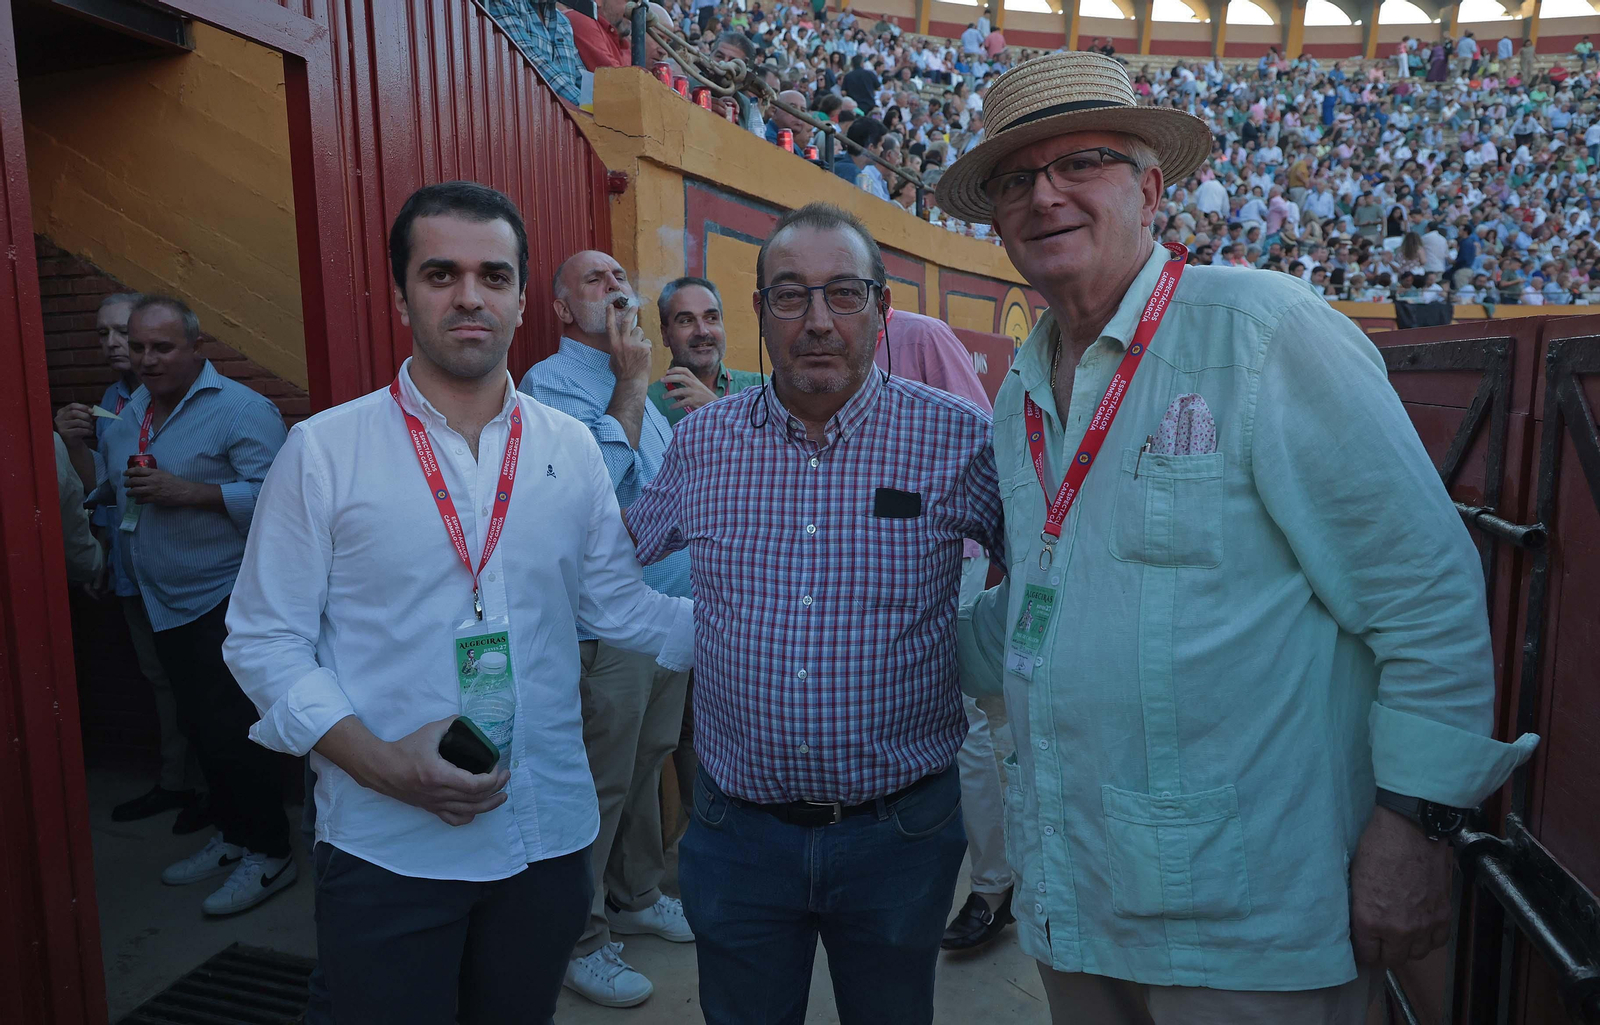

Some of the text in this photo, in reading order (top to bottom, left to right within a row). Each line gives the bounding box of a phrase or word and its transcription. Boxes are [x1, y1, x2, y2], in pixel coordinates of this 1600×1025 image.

[1142, 272, 1169, 322] CARMELO GARCÍA
[1151, 277, 1175, 321] ESPECTÁCULOS
[1090, 374, 1121, 431] CARMELO GARCÍA
[1099, 380, 1126, 431] ESPECTÁCULOS
[411, 430, 432, 477] CARMELO GARCÍA
[418, 431, 438, 472] ESPECTÁCULOS
[502, 437, 514, 476] ESPECTÁCULOS
[508, 456, 517, 480] CARMELO
[1052, 482, 1070, 514] CARMELO
[444, 514, 458, 541] CARMELO
[451, 516, 468, 558] ESPECTÁCULOS
[1026, 590, 1054, 604] ALGECIRAS
[459, 636, 506, 650] ALGECIRAS
